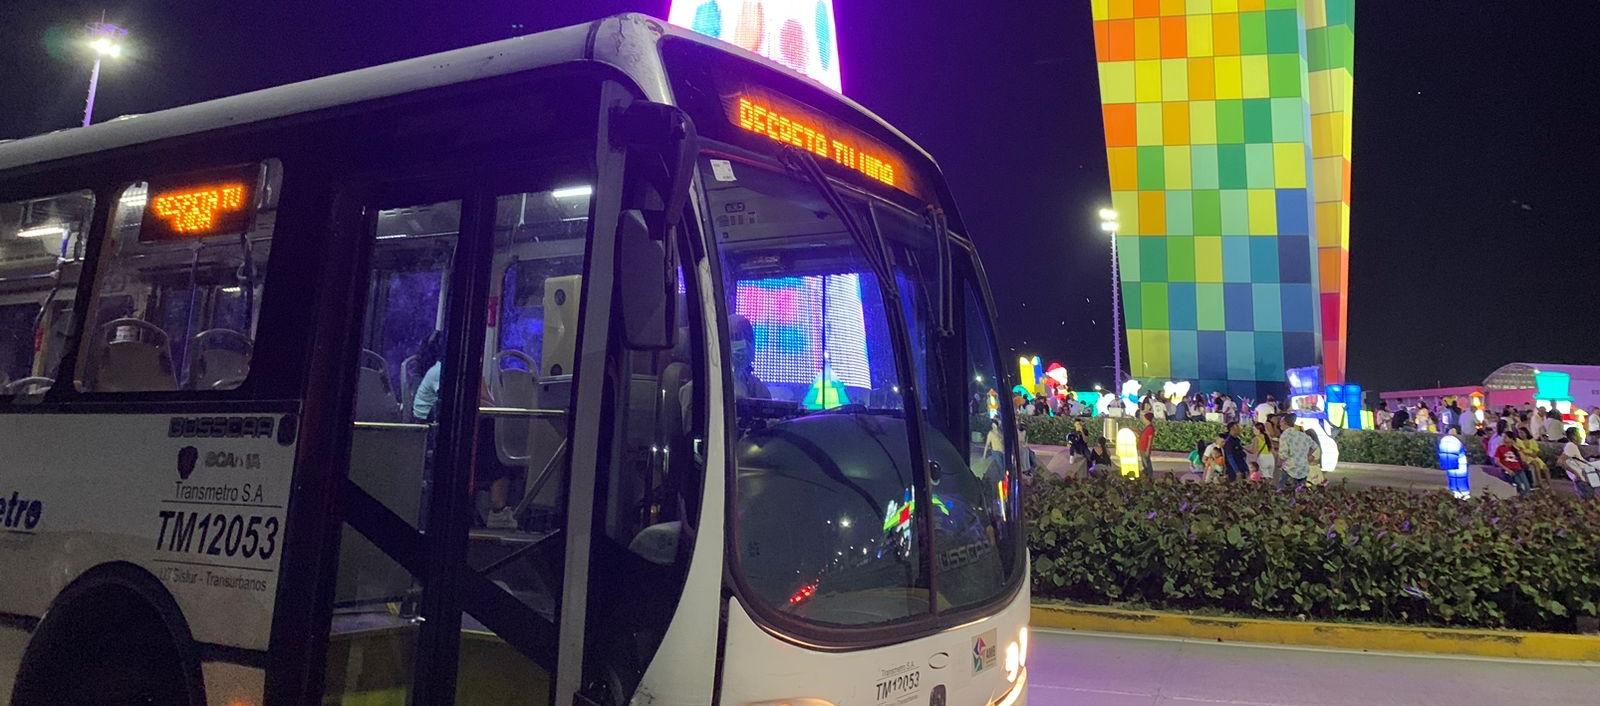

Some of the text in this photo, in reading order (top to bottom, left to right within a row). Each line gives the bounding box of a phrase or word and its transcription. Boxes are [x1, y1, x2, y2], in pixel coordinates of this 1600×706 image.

[175, 480, 239, 502] Transmetro
[155, 510, 279, 561] TM12053
[876, 670, 920, 701] TM12053
